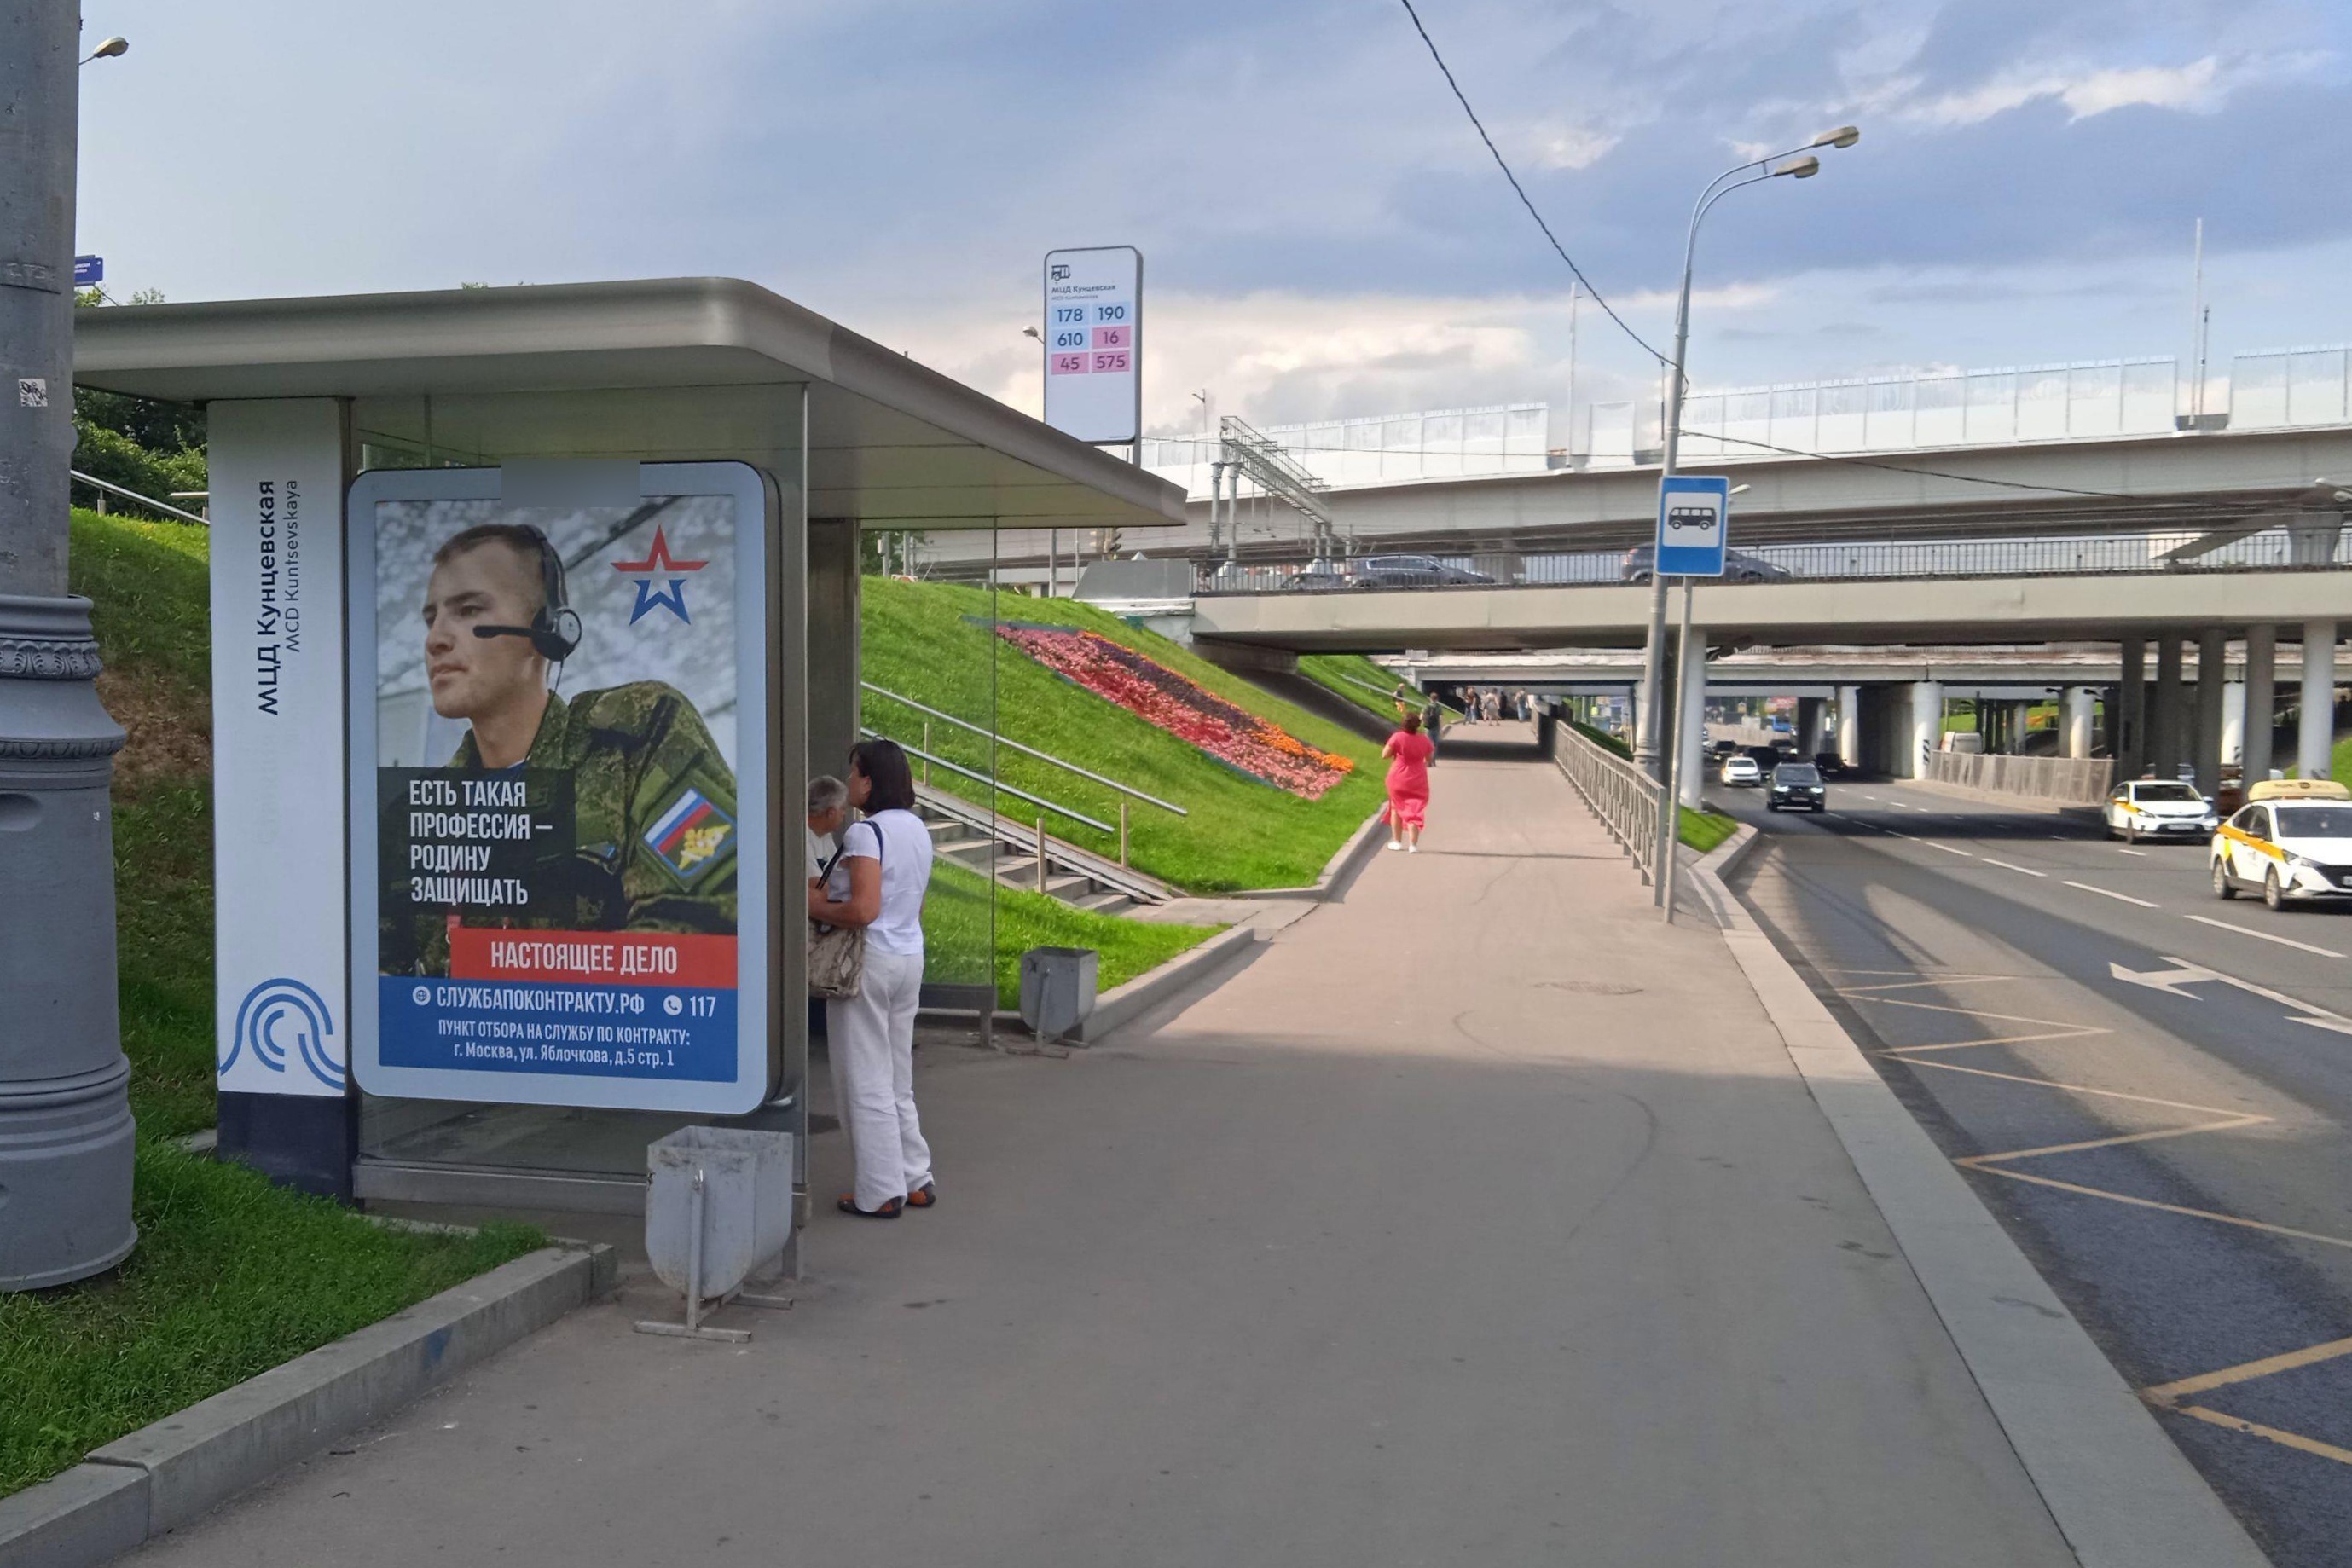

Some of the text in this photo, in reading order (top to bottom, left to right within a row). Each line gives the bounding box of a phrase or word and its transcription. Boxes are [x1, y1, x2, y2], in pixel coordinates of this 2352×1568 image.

[1057, 306, 1125, 322] 178 190
[1057, 330, 1119, 346] 610 16
[1060, 355, 1126, 370] 45 575
[283, 480, 301, 652] MCD Kuntsevskaya
[257, 481, 281, 715] МЦД Кунцевская
[409, 779, 526, 807] ЕСТЬ ТАКАЯ
[409, 812, 530, 840] ПРОФЕССИЯ
[410, 844, 491, 873] РОДИНУ
[411, 877, 529, 906] ЗАЩИЩАТЬ
[490, 940, 678, 975] НАСТОЯЩЕЕ ДЕЛО
[437, 986, 716, 1018] СЛУЖБАПОКОНТРАКТУ.РФ 117
[438, 1019, 691, 1045] ПУНКТ ОТБОРА НА СЛУЖБУ ПО КОНТРАКТУ:
[454, 1044, 463, 1056] г.
[466, 1042, 518, 1062] Москва,
[518, 1047, 538, 1062] ул.
[541, 1044, 613, 1066] Яблочкова,
[637, 1052, 664, 1069] стр.
[667, 1050, 675, 1066] 1
